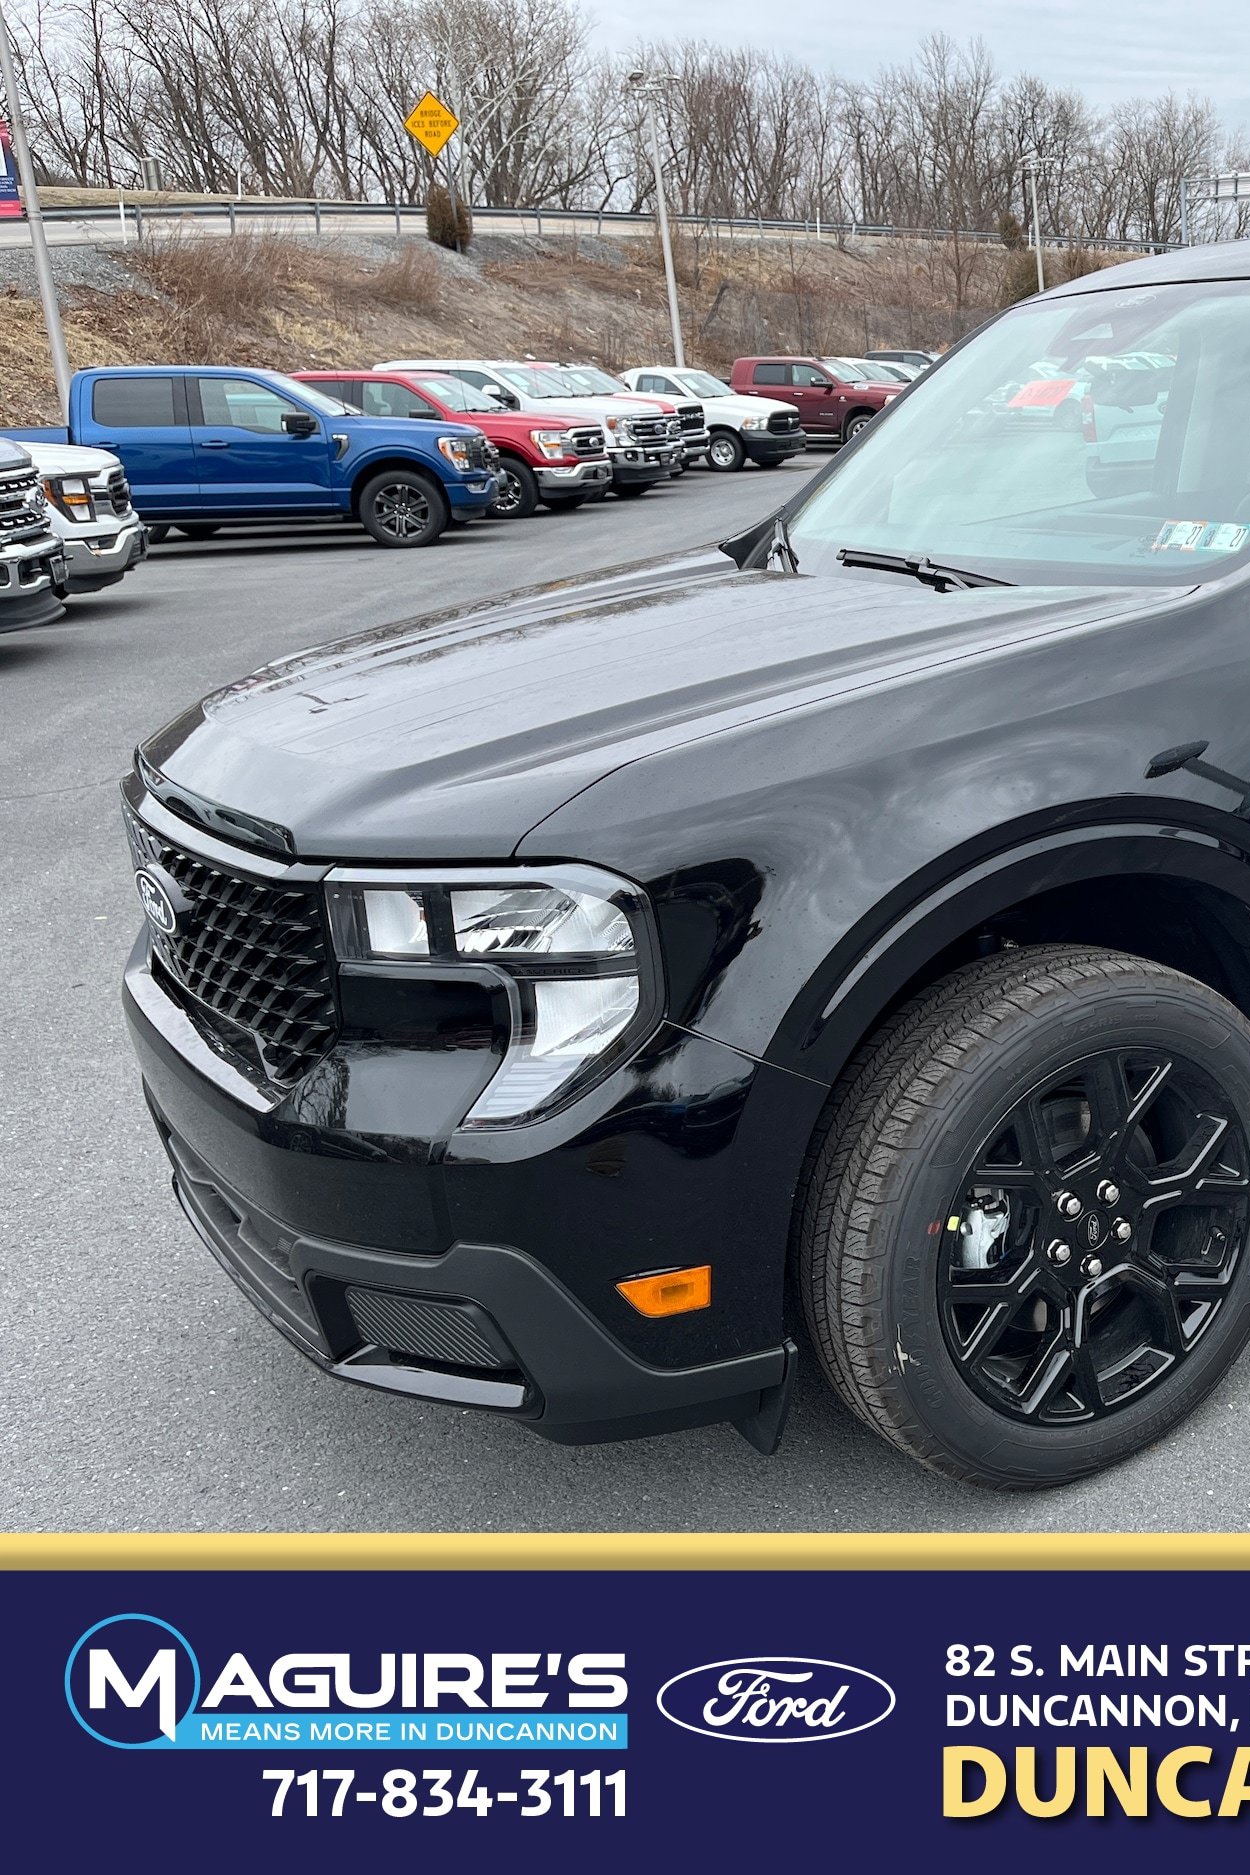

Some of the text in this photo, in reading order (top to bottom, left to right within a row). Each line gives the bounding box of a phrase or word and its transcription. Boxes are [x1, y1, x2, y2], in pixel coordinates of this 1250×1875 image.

[429, 120, 452, 128] BEFORE
[1185, 526, 1203, 545] 27
[1229, 528, 1247, 547] 27
[141, 876, 168, 927] Ford
